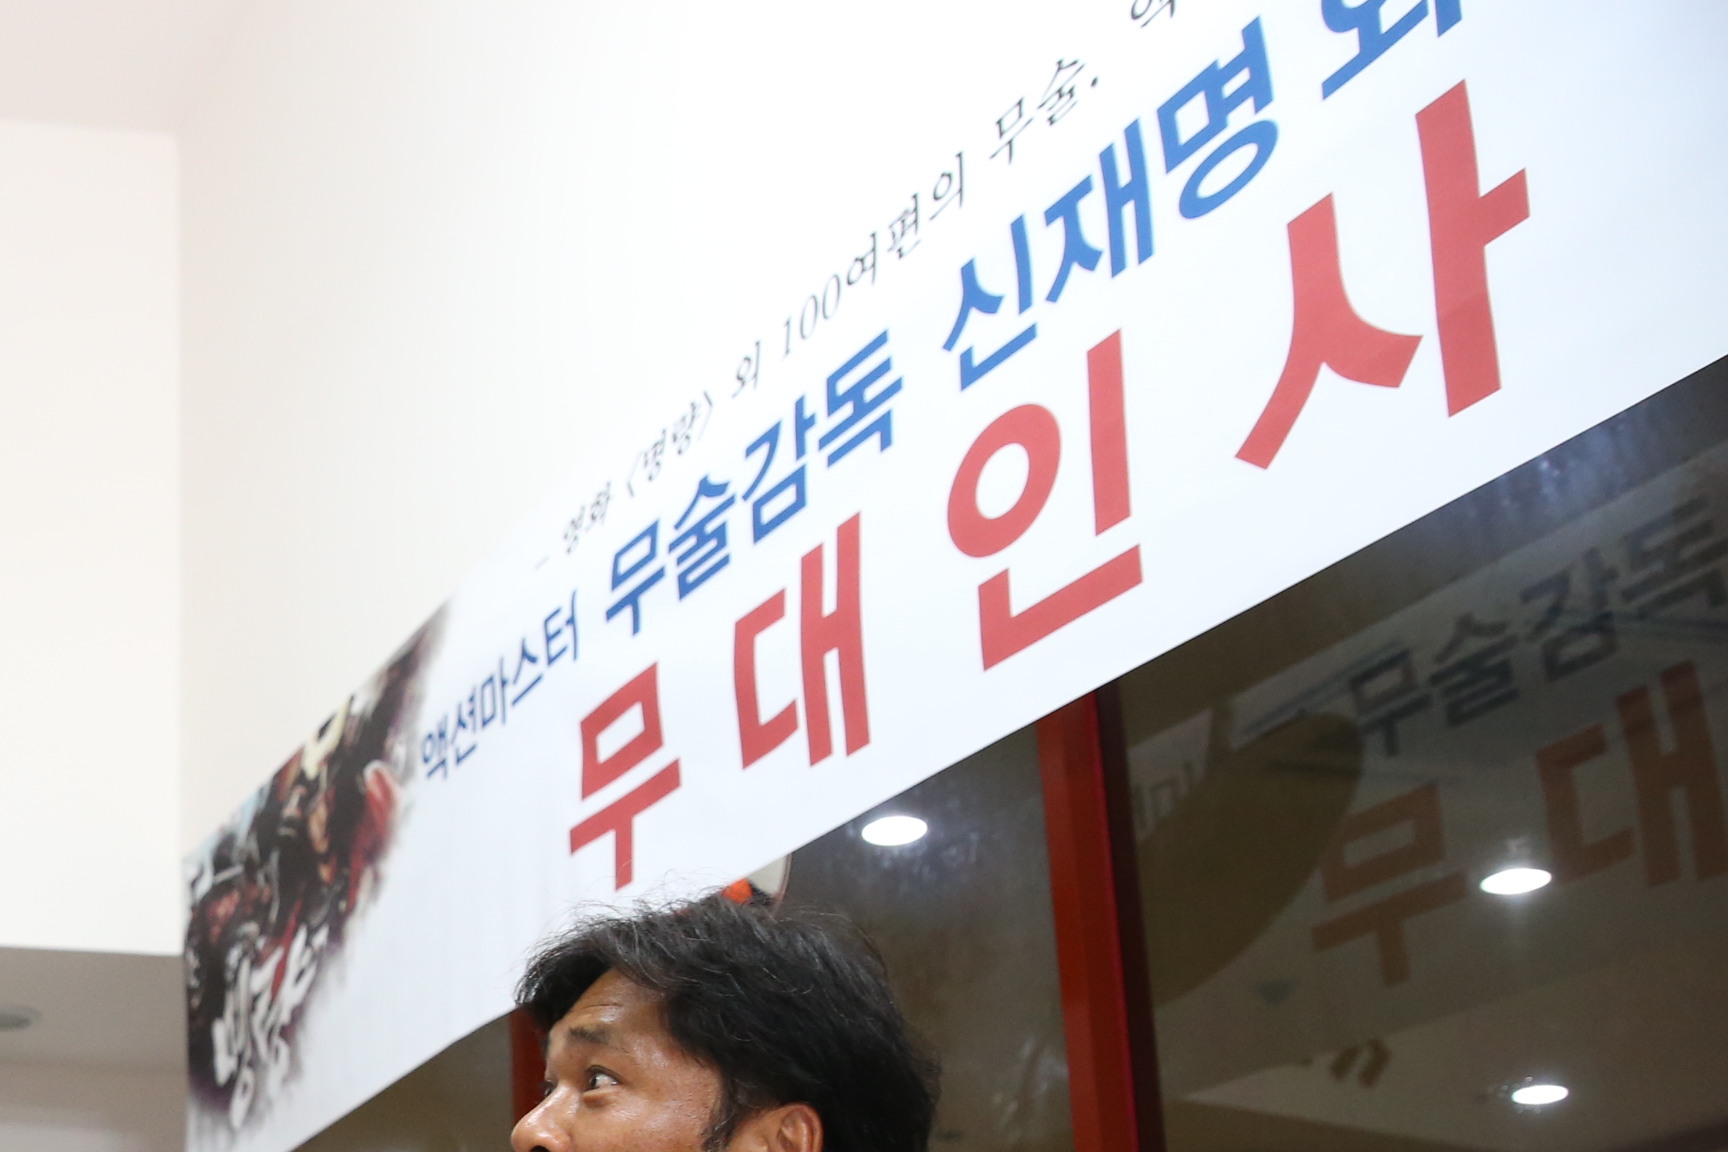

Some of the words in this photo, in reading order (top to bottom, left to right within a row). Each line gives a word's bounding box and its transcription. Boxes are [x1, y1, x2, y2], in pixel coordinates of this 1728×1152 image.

[421, 590, 580, 780] 액션마스터
[605, 329, 904, 637] 무술감독
[942, 15, 1280, 391] 신재명
